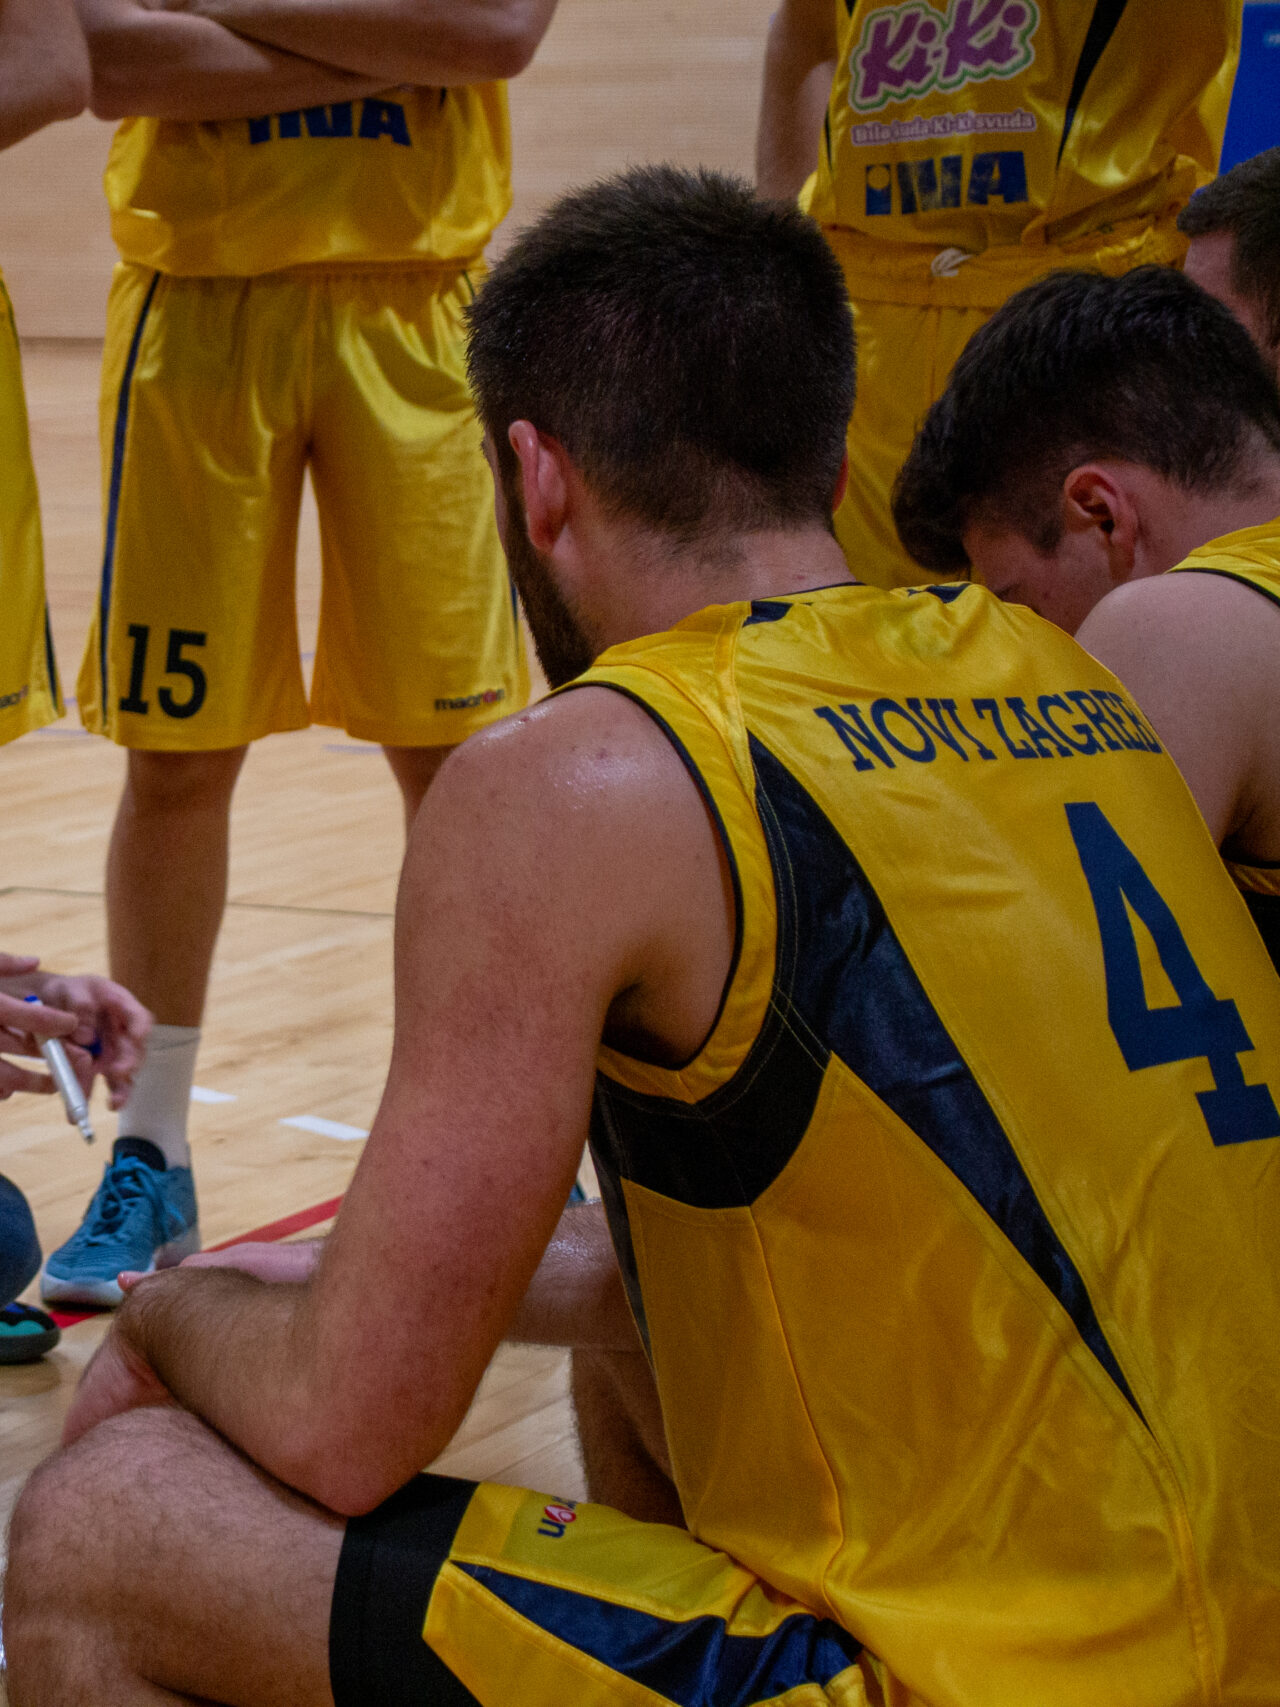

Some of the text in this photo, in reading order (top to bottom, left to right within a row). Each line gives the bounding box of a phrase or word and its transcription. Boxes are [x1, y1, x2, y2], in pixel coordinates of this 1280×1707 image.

[119, 624, 208, 719] 15
[812, 688, 1163, 772] NOVI ZAGREB
[1063, 801, 1280, 1148] 4
